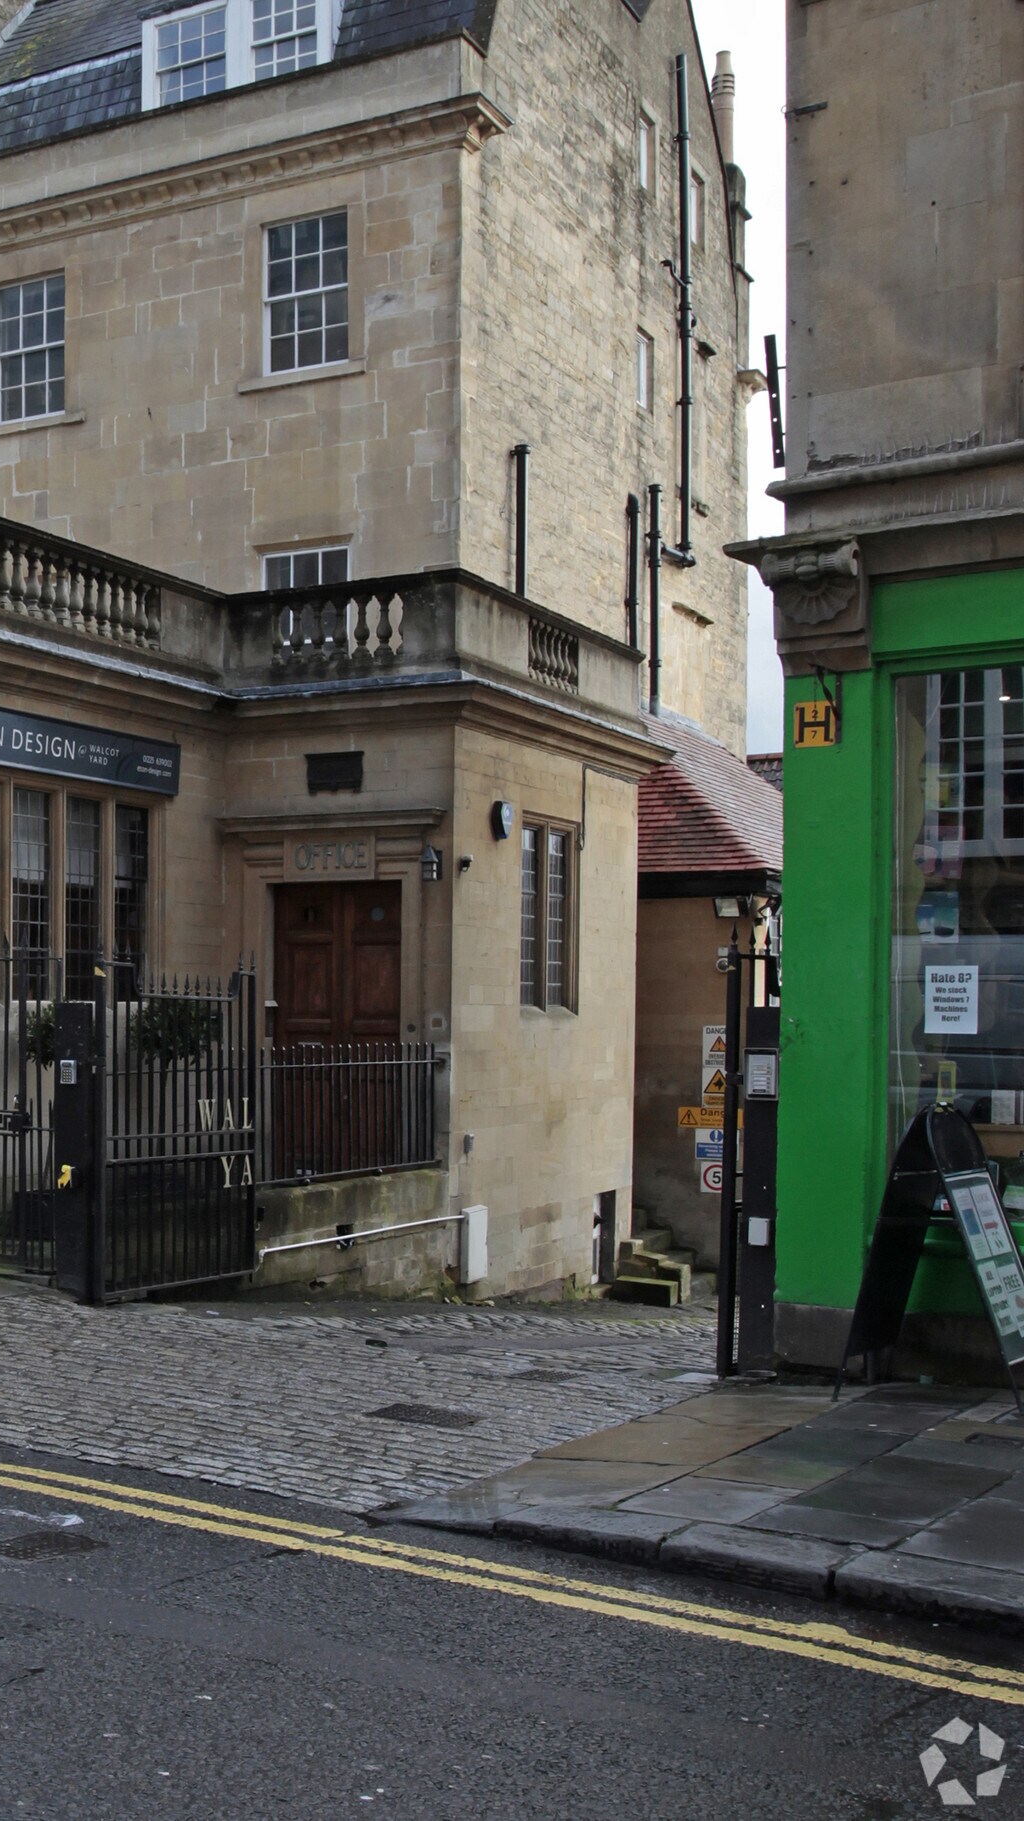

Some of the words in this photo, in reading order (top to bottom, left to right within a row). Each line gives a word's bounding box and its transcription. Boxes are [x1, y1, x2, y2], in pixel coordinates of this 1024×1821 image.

[798, 705, 831, 743] H
[811, 730, 817, 739] 7
[11, 728, 76, 760] DESIGN
[77, 744, 87, 758] @
[89, 744, 119, 757] WALCOT
[89, 754, 108, 766] YARD
[294, 842, 367, 871] OFFICE
[931, 973, 955, 983] Hate
[958, 972, 972, 983] 8?
[934, 1005, 968, 1013] Machines
[197, 1097, 253, 1132] WAL
[220, 1154, 253, 1188] YA
[712, 1171, 721, 1184] 5
[1003, 1273, 1022, 1291] FREE
